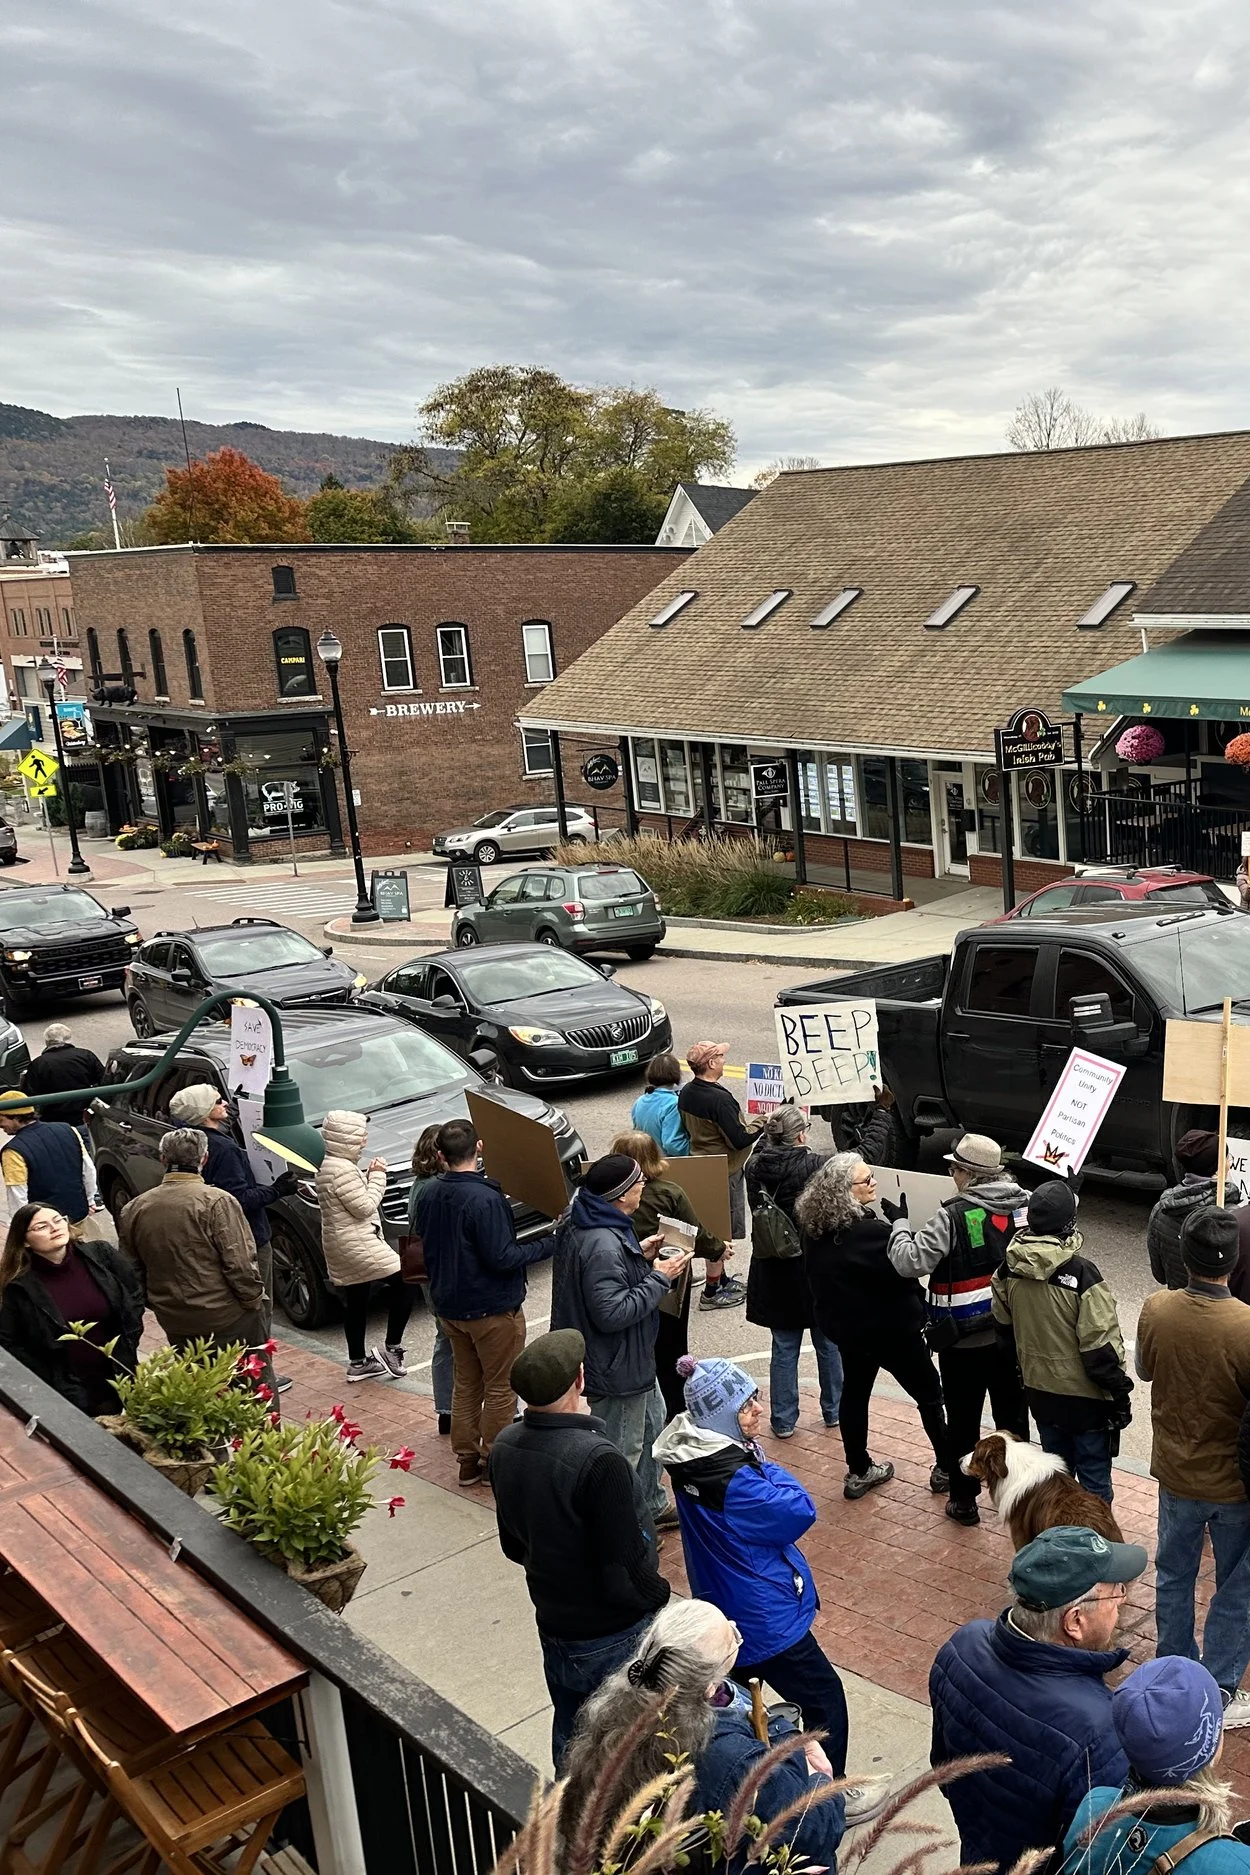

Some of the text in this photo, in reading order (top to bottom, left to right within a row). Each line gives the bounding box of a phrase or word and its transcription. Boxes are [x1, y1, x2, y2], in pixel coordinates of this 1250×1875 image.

[385, 701, 467, 717] BREWERY
[1013, 751, 1056, 765] Irish Pub
[757, 783, 785, 791] COMPANY
[244, 1020, 263, 1034] SAVE
[781, 1010, 871, 1056] BEEP
[235, 1040, 266, 1054] DEMOCRACY
[762, 1067, 773, 1079] NO
[788, 1050, 877, 1097] BEEP!
[1073, 1064, 1113, 1085] Community
[753, 1082, 764, 1097] NO
[1078, 1080, 1097, 1094] Unity
[1070, 1099, 1088, 1110] NOT
[1057, 1111, 1086, 1128] Partisan
[1050, 1128, 1076, 1145] Politics
[1229, 1157, 1248, 1172] WE
